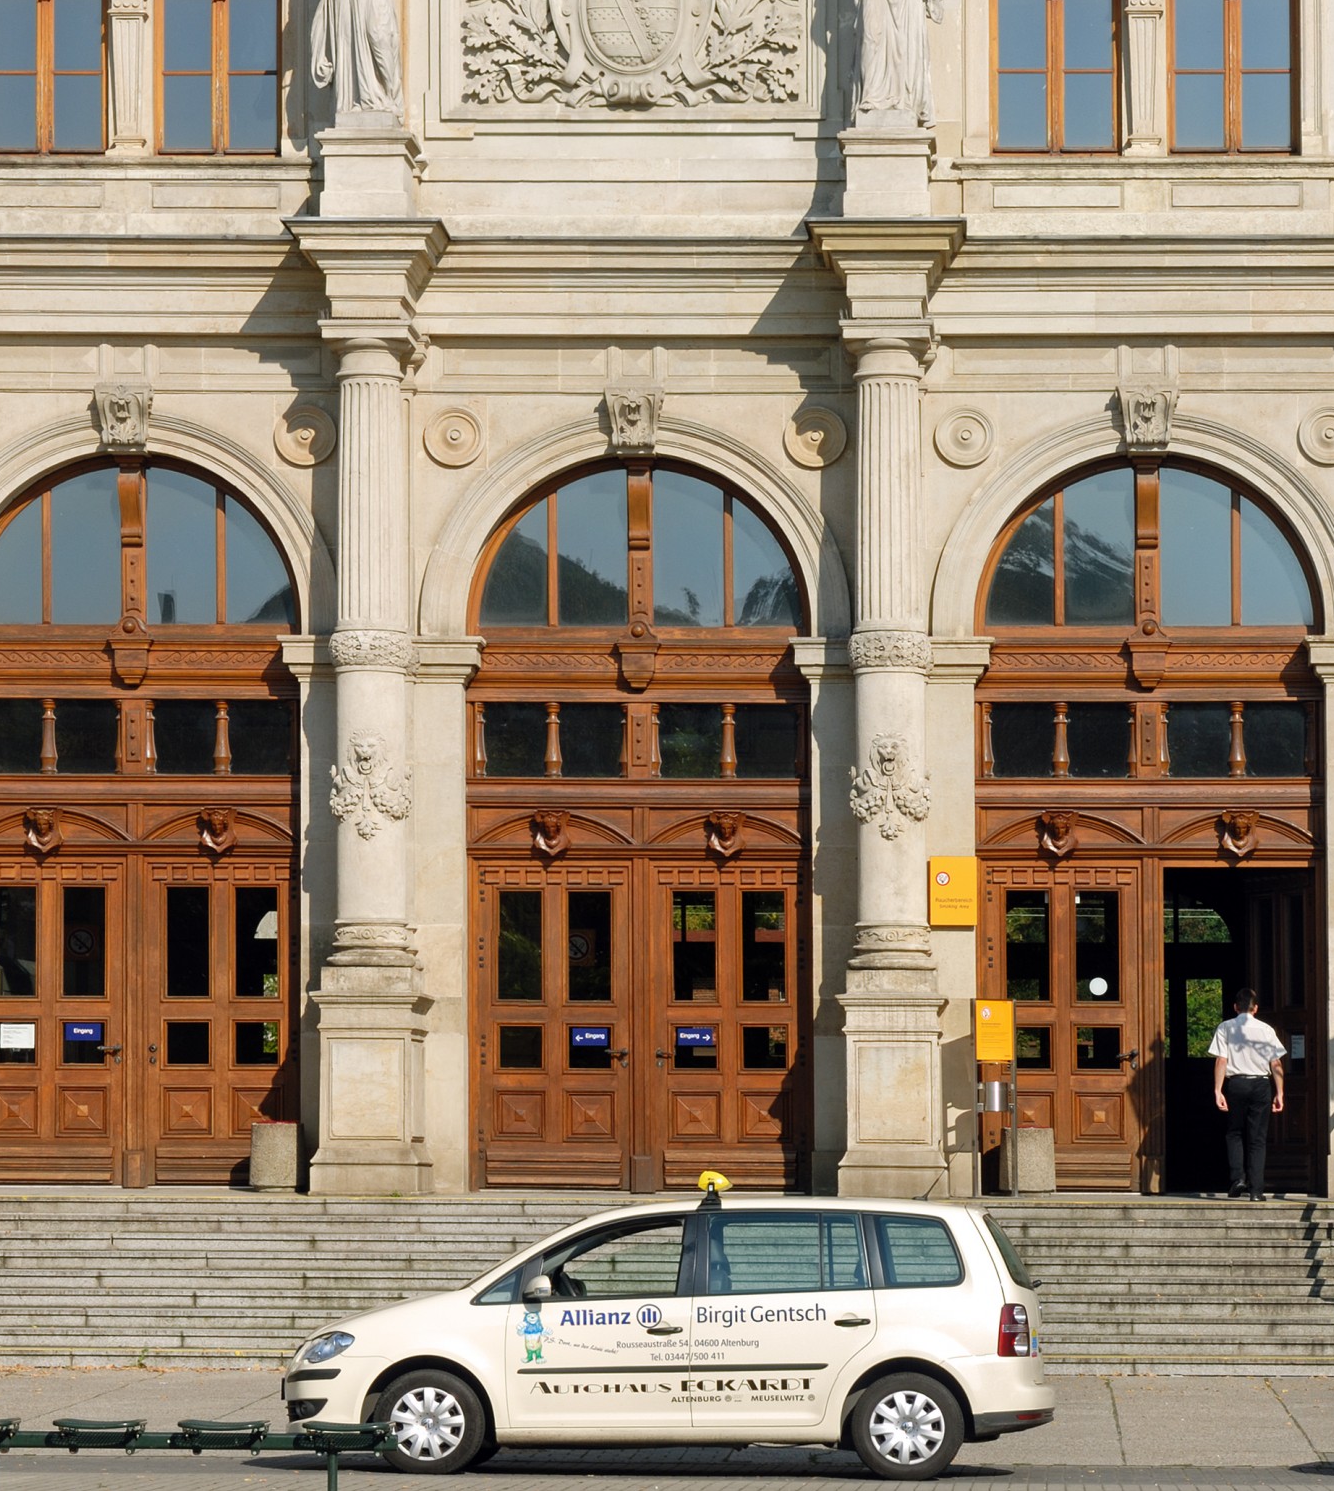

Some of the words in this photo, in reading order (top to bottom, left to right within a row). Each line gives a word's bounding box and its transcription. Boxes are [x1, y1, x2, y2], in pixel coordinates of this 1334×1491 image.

[73, 1027, 93, 1035] Eingang
[560, 1309, 631, 1326] Allianz
[697, 1305, 746, 1328] Birgit
[750, 1303, 826, 1322] Gentsch
[616, 1338, 677, 1349] Rousseaustraße
[694, 1338, 719, 1347] 04600
[720, 1338, 760, 1349] Altenburg
[650, 1353, 663, 1362] Tel.
[711, 1352, 725, 1360] 411
[681, 1377, 815, 1392] ECKARDT
[671, 1395, 722, 1403] ALTENBURG
[751, 1394, 805, 1403] MEUSELWITZ
